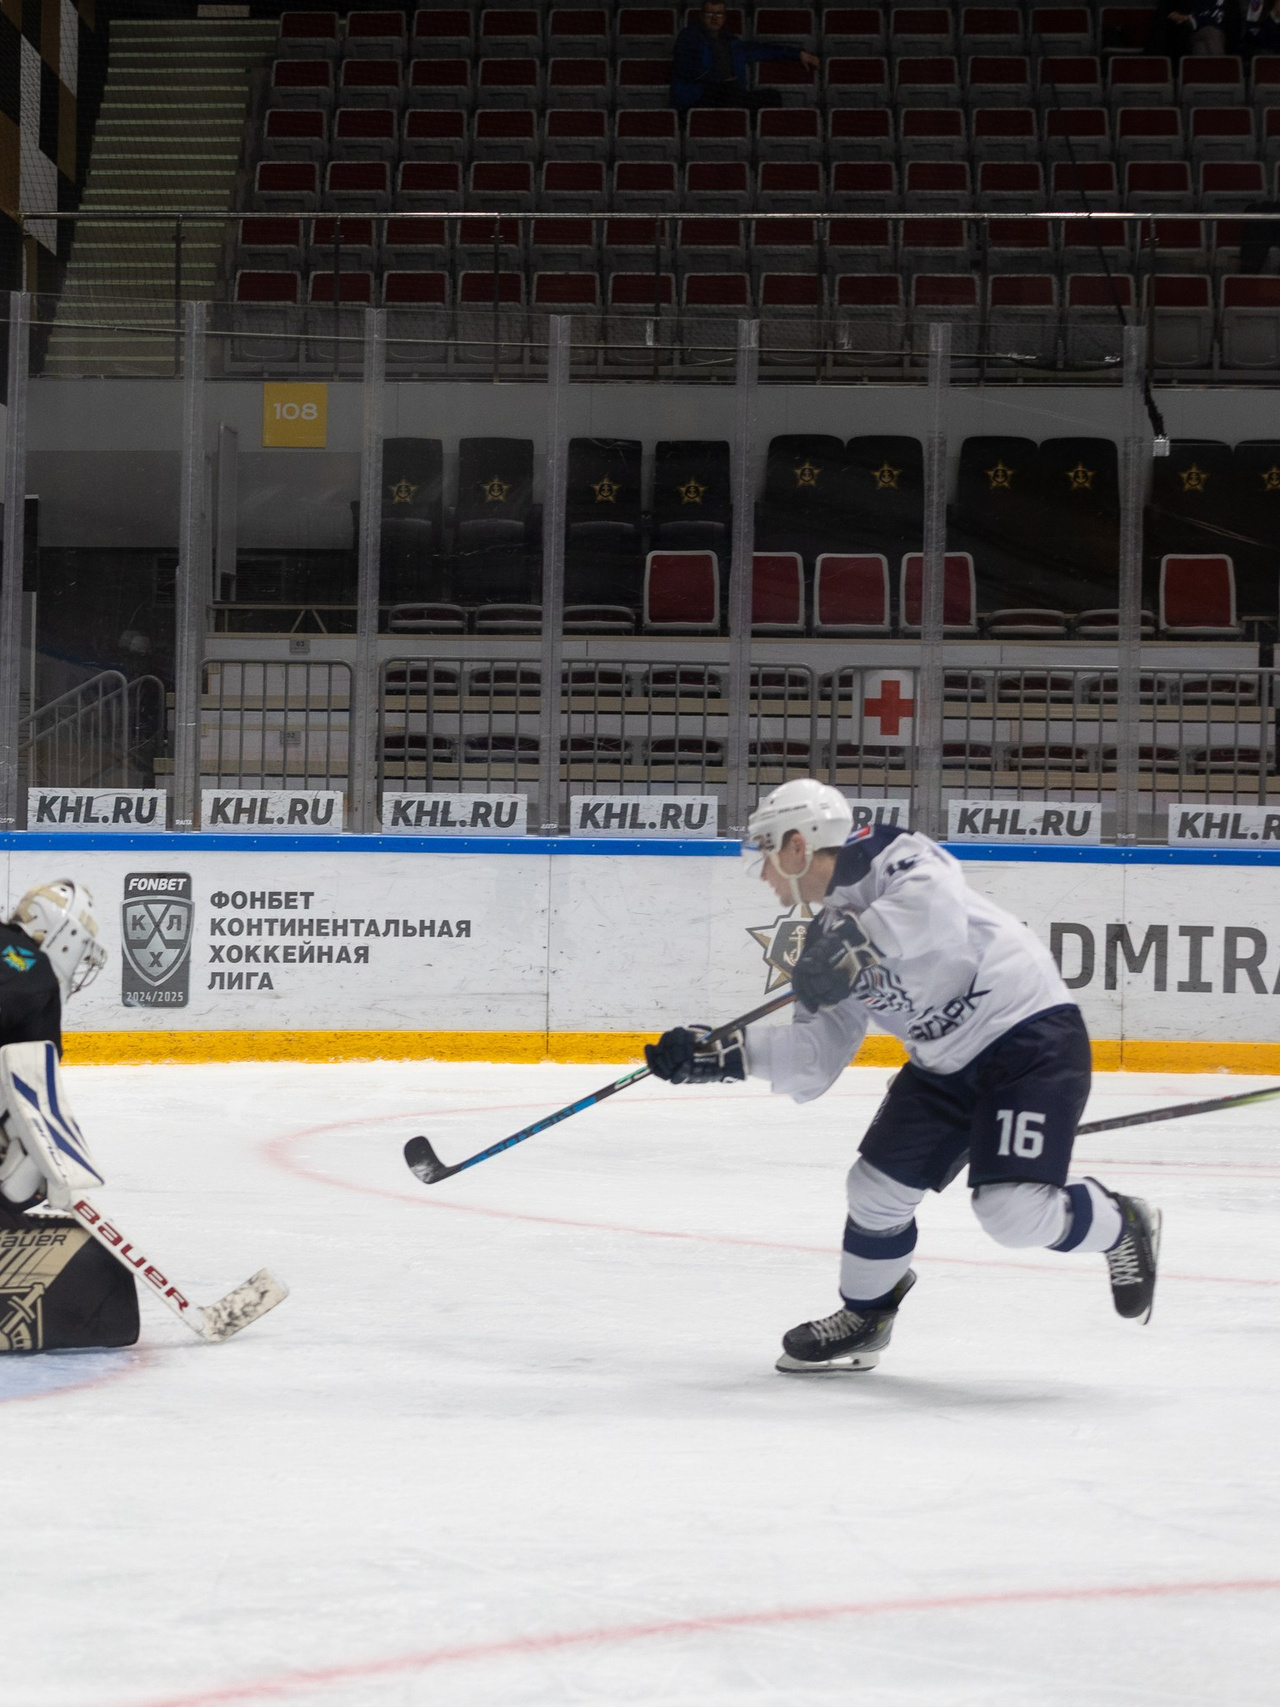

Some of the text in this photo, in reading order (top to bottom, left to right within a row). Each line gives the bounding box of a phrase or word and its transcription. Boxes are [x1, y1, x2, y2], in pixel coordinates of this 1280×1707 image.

[273, 402, 319, 421] 108
[35, 795, 158, 824] KHL.RU
[209, 796, 335, 826] KHL.RU
[390, 799, 519, 829] KHL.RU
[578, 801, 710, 830] KHL.RU
[956, 806, 1093, 838] KHL.RU
[1177, 811, 1280, 841] KHL.R
[128, 877, 187, 892] FONBET
[209, 891, 315, 910] ФОНБЕТ
[209, 917, 472, 938] КОНТИНЕНТАЛЬНАЯ
[208, 941, 370, 964] ХОККЕЙНАЯ
[1048, 922, 1280, 995] DMIR
[207, 971, 275, 991] ЛИГА
[126, 990, 184, 1004] 2024/2025
[995, 1109, 1047, 1160] 16
[72, 1199, 189, 1312] BAUER
